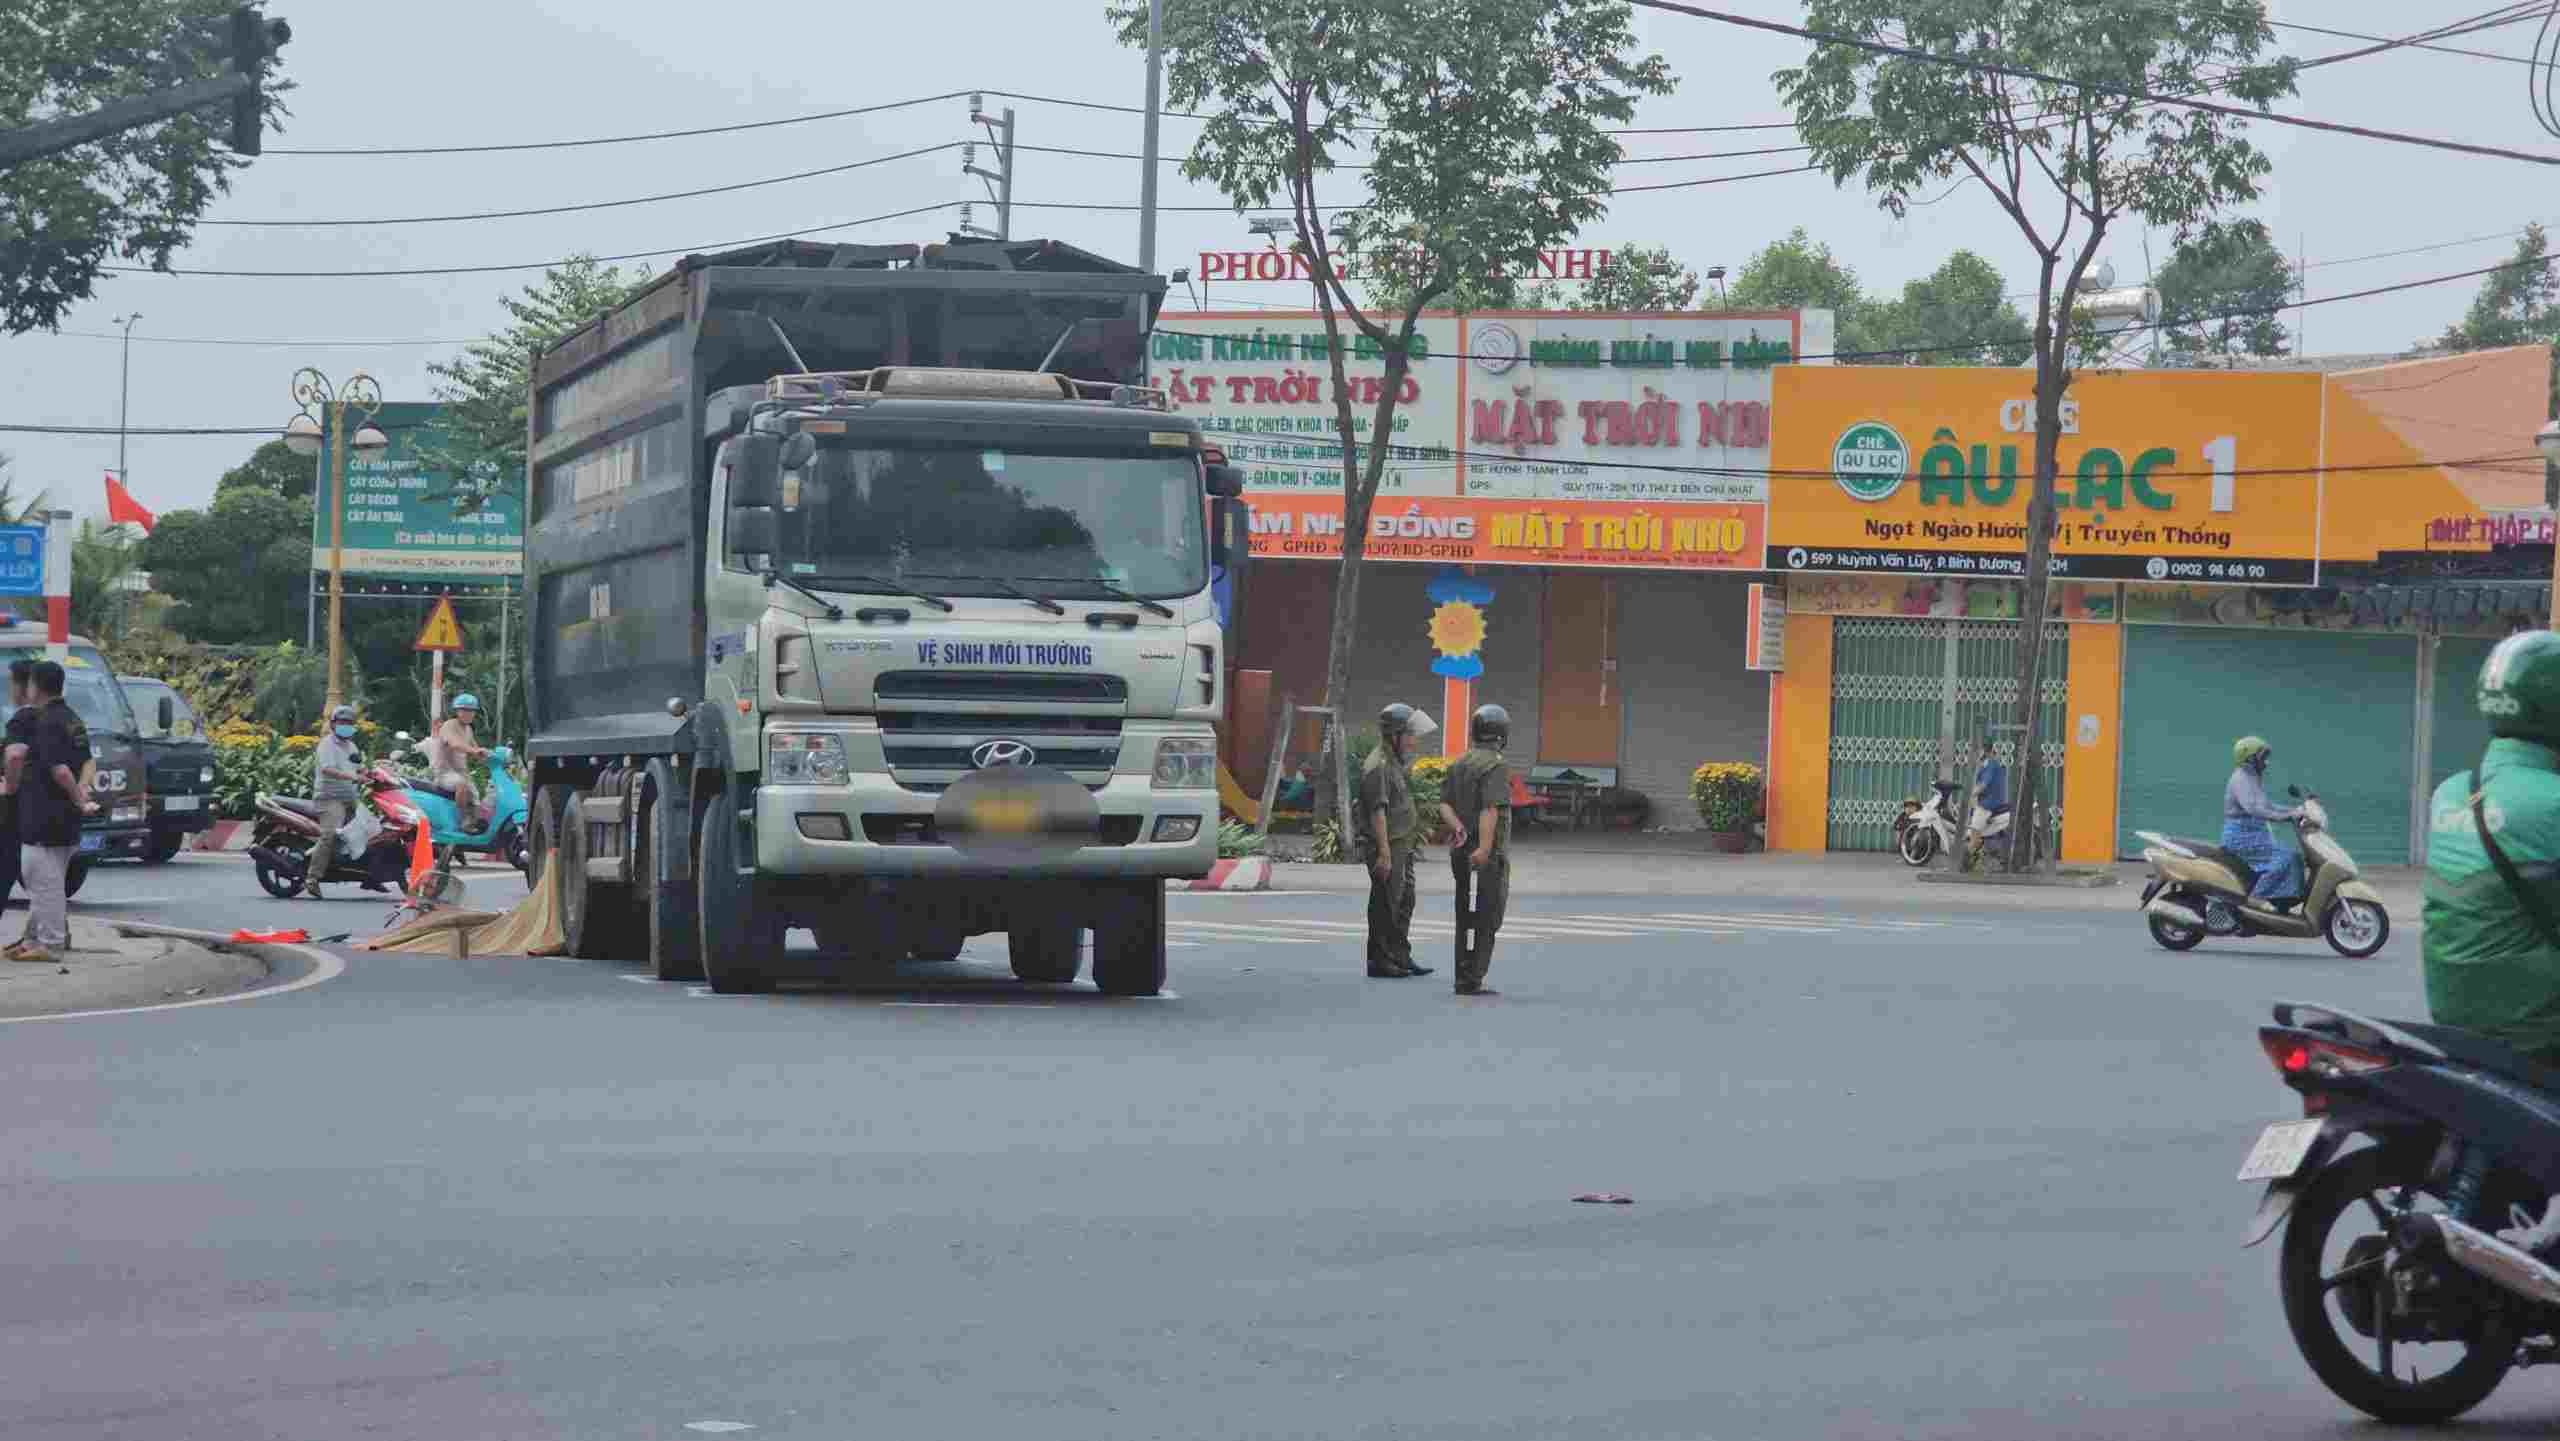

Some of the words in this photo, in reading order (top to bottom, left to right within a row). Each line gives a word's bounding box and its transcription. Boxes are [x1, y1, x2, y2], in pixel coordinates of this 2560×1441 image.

[1224, 368, 1322, 403] TRỜI
[1471, 384, 1565, 456] MẶT
[1578, 385, 1682, 447] TRỜI
[1697, 399, 1770, 449] NH
[1919, 427, 2017, 508] ÂU
[2203, 436, 2236, 512] 1
[1374, 502, 1474, 539] ĐỒNG
[1489, 505, 1573, 556] MẶT
[1582, 506, 1664, 552] TRỜI
[1671, 504, 1744, 552] NHỎ
[1865, 520, 1914, 540] Ngọt
[1922, 518, 1973, 541] Ngào
[2162, 521, 2232, 550] Thống
[1811, 553, 1833, 564] 599
[1837, 553, 1877, 569] Huỳnh
[2171, 562, 2202, 575] 0902
[918, 640, 938, 668] VỆ
[943, 643, 984, 664] SINH
[989, 640, 1021, 665] MÔI
[1025, 640, 1092, 665] TRƯỜNG
